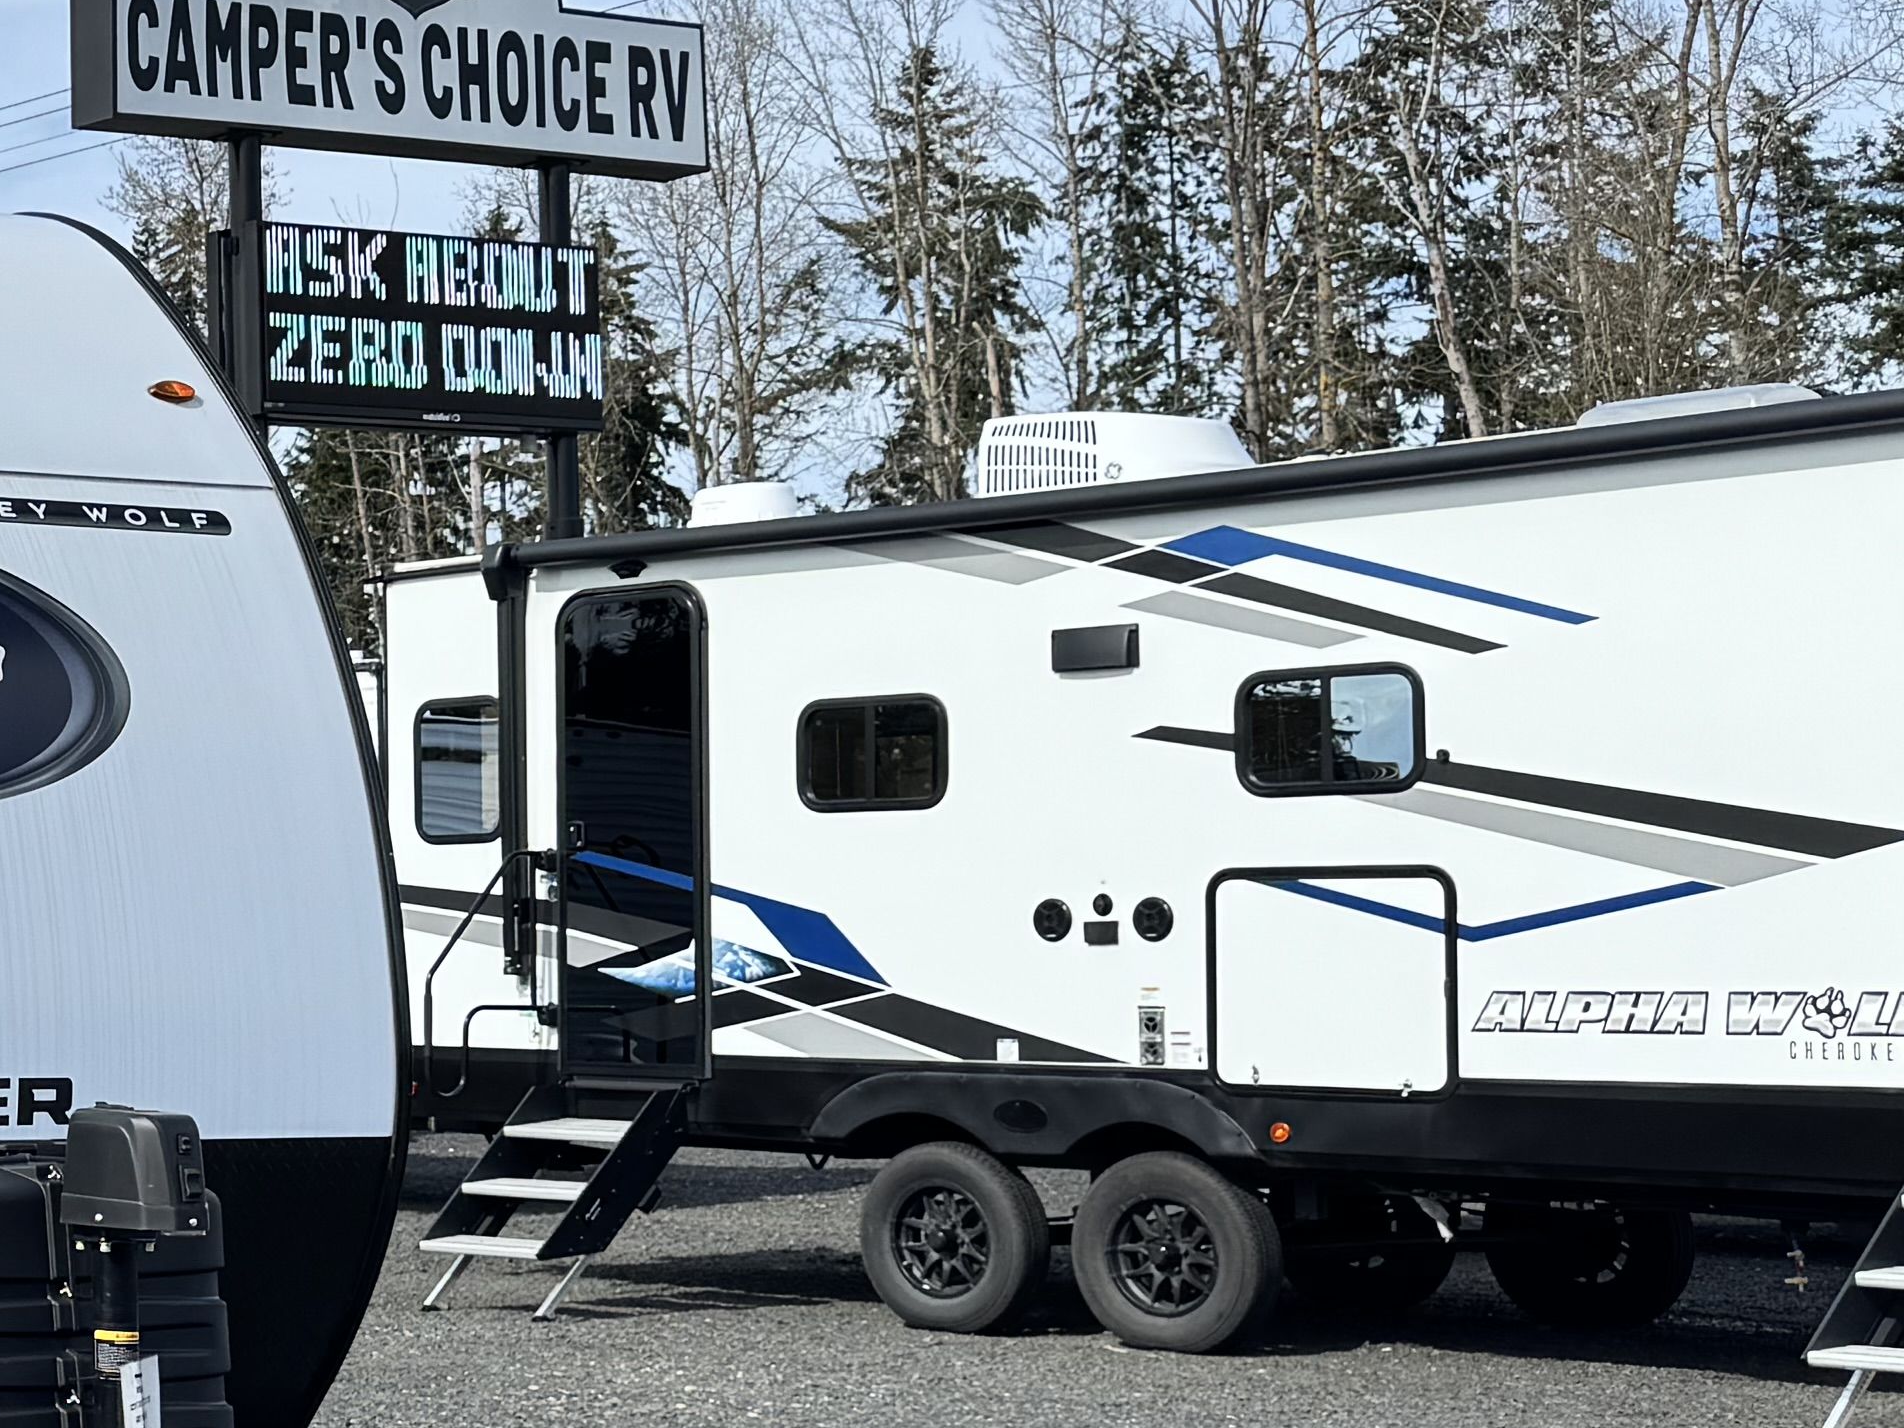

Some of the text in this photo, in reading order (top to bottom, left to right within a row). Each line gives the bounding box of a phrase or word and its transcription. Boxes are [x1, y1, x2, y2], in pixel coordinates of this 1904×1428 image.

[421, 23, 615, 135] CHOICE
[630, 44, 690, 142] RV
[266, 225, 595, 316] ASK ABOUT
[269, 312, 428, 389] ZERO
[81, 504, 208, 529] WOLF
[1471, 990, 1709, 1035] ALPHA
